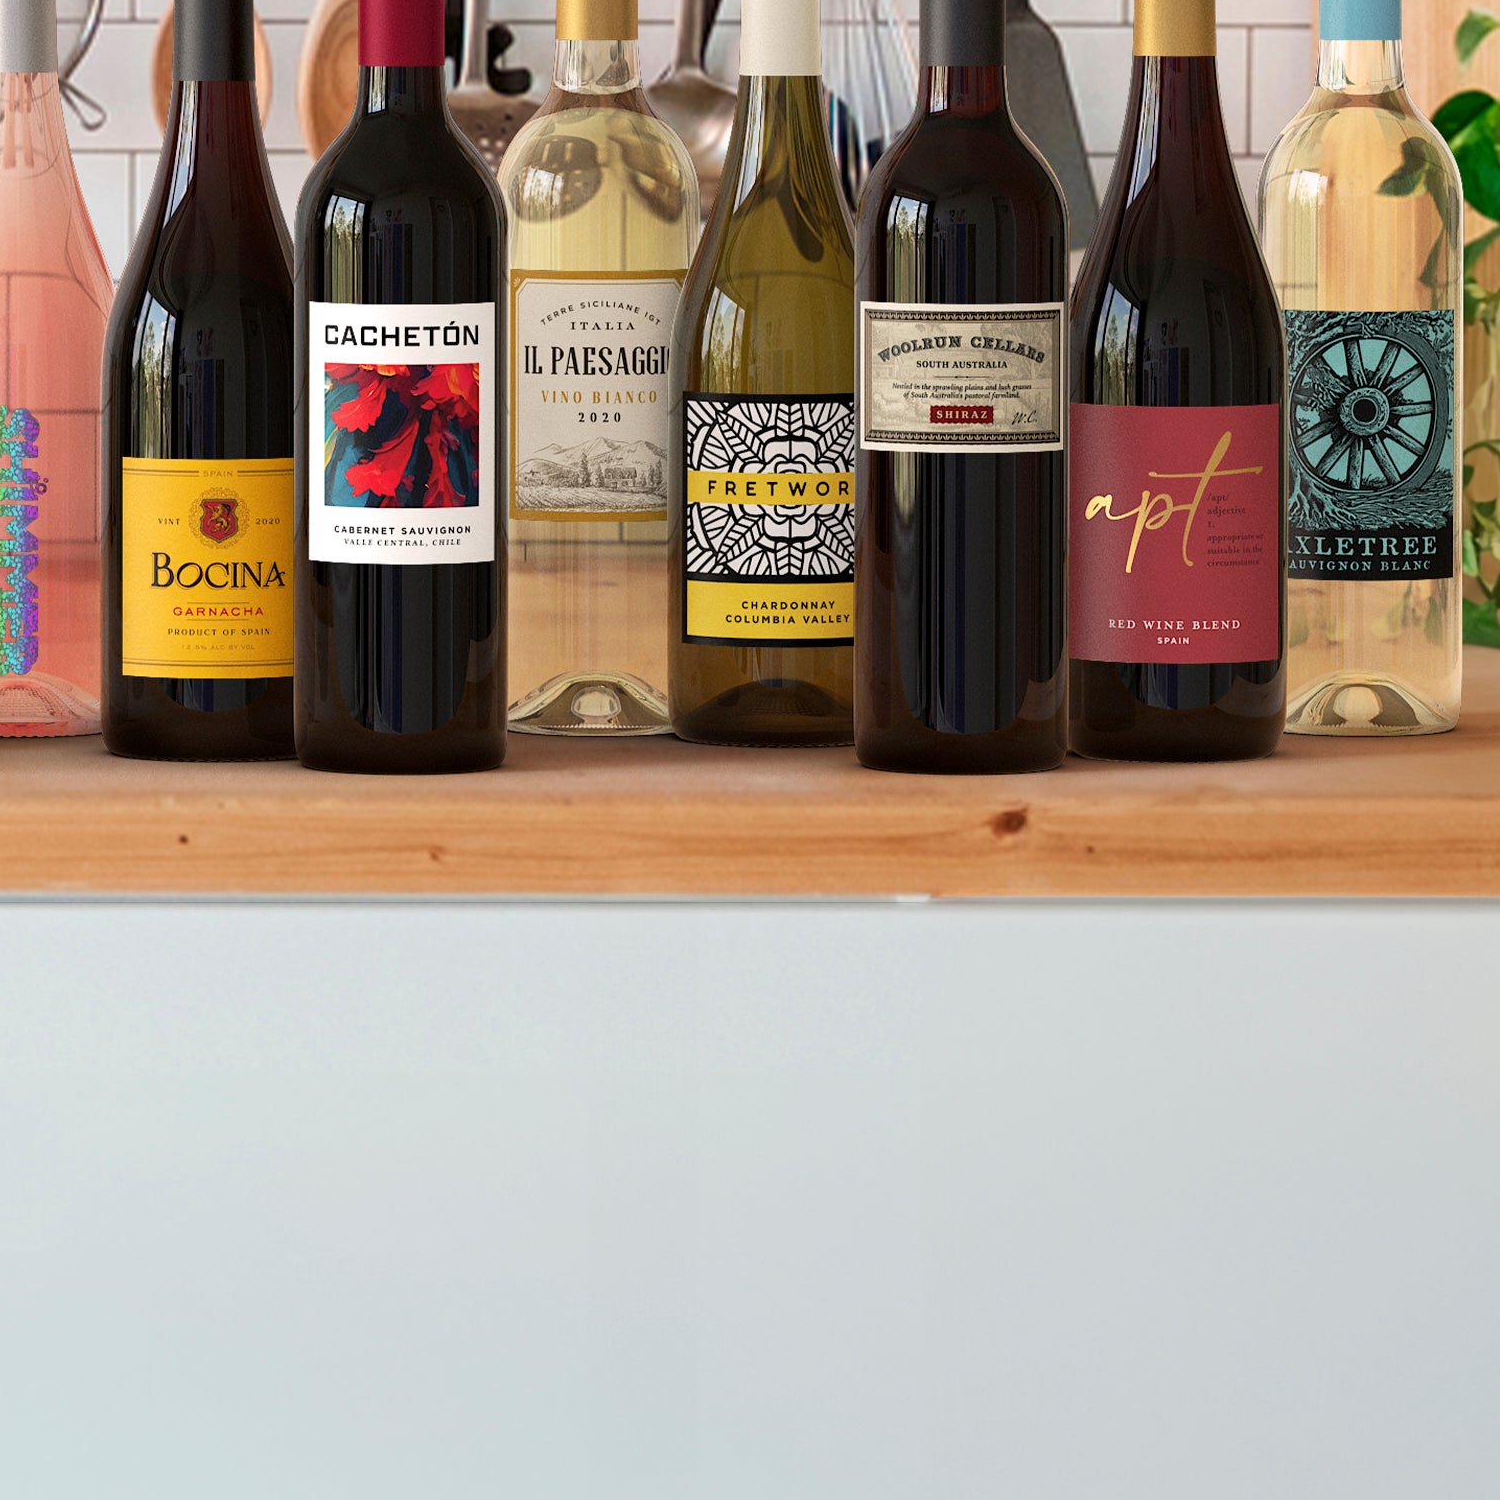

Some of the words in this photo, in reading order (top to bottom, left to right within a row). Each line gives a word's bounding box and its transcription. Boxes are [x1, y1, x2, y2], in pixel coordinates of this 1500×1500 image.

[540, 304, 575, 326] TERRE
[580, 300, 640, 314] SICILIANE
[644, 311, 661, 326] IGT
[569, 321, 636, 331] ITALIA
[324, 321, 479, 347] CACHETÓN
[877, 335, 963, 363] WOOLRUN
[970, 336, 1046, 364] CELLARS
[524, 345, 543, 375] IL
[550, 345, 669, 376] PAESAGGI
[916, 360, 949, 369] SOUTH
[951, 360, 1008, 369] AUSTRALIA
[892, 382, 913, 390] Nestled
[921, 382, 931, 390] the
[932, 383, 964, 393] sprawling
[964, 384, 985, 392] plains
[985, 383, 997, 391] and
[541, 390, 582, 404] VINO
[592, 390, 657, 404] BIANCO
[903, 390, 910, 399] of
[910, 390, 928, 399] South
[931, 390, 963, 400] Australia's
[964, 390, 991, 400] pastoral
[578, 412, 622, 424] 2020
[936, 410, 989, 420] SHIRAZ
[202, 470, 234, 478] SPAIN
[708, 480, 850, 497] FRETWOR
[1085, 430, 1263, 574] apt
[1206, 505, 1247, 518] adjective
[334, 525, 396, 535] CABERNET
[401, 525, 472, 536] SAUVIGNON
[344, 538, 373, 546] VALLE
[377, 538, 428, 548] CENTRAL,
[432, 538, 461, 546] CHILE
[1287, 535, 1437, 557] XLETREE
[150, 551, 286, 590] BOCINA
[1288, 559, 1372, 572] AUVIGNON
[1380, 560, 1431, 571] BLANC
[741, 600, 836, 610] CHARDONNAY
[172, 606, 264, 617] GARNACHA
[725, 614, 796, 625] COLUMBIA
[802, 614, 850, 624] VALLEY
[1108, 618, 1136, 629] RED
[1143, 620, 1185, 630] WINE
[1192, 619, 1241, 630] BLEND
[167, 627, 217, 636] PRODUCT
[222, 628, 236, 636] OF
[241, 627, 270, 636] SPAIN
[1157, 636, 1190, 645] SPAIN
